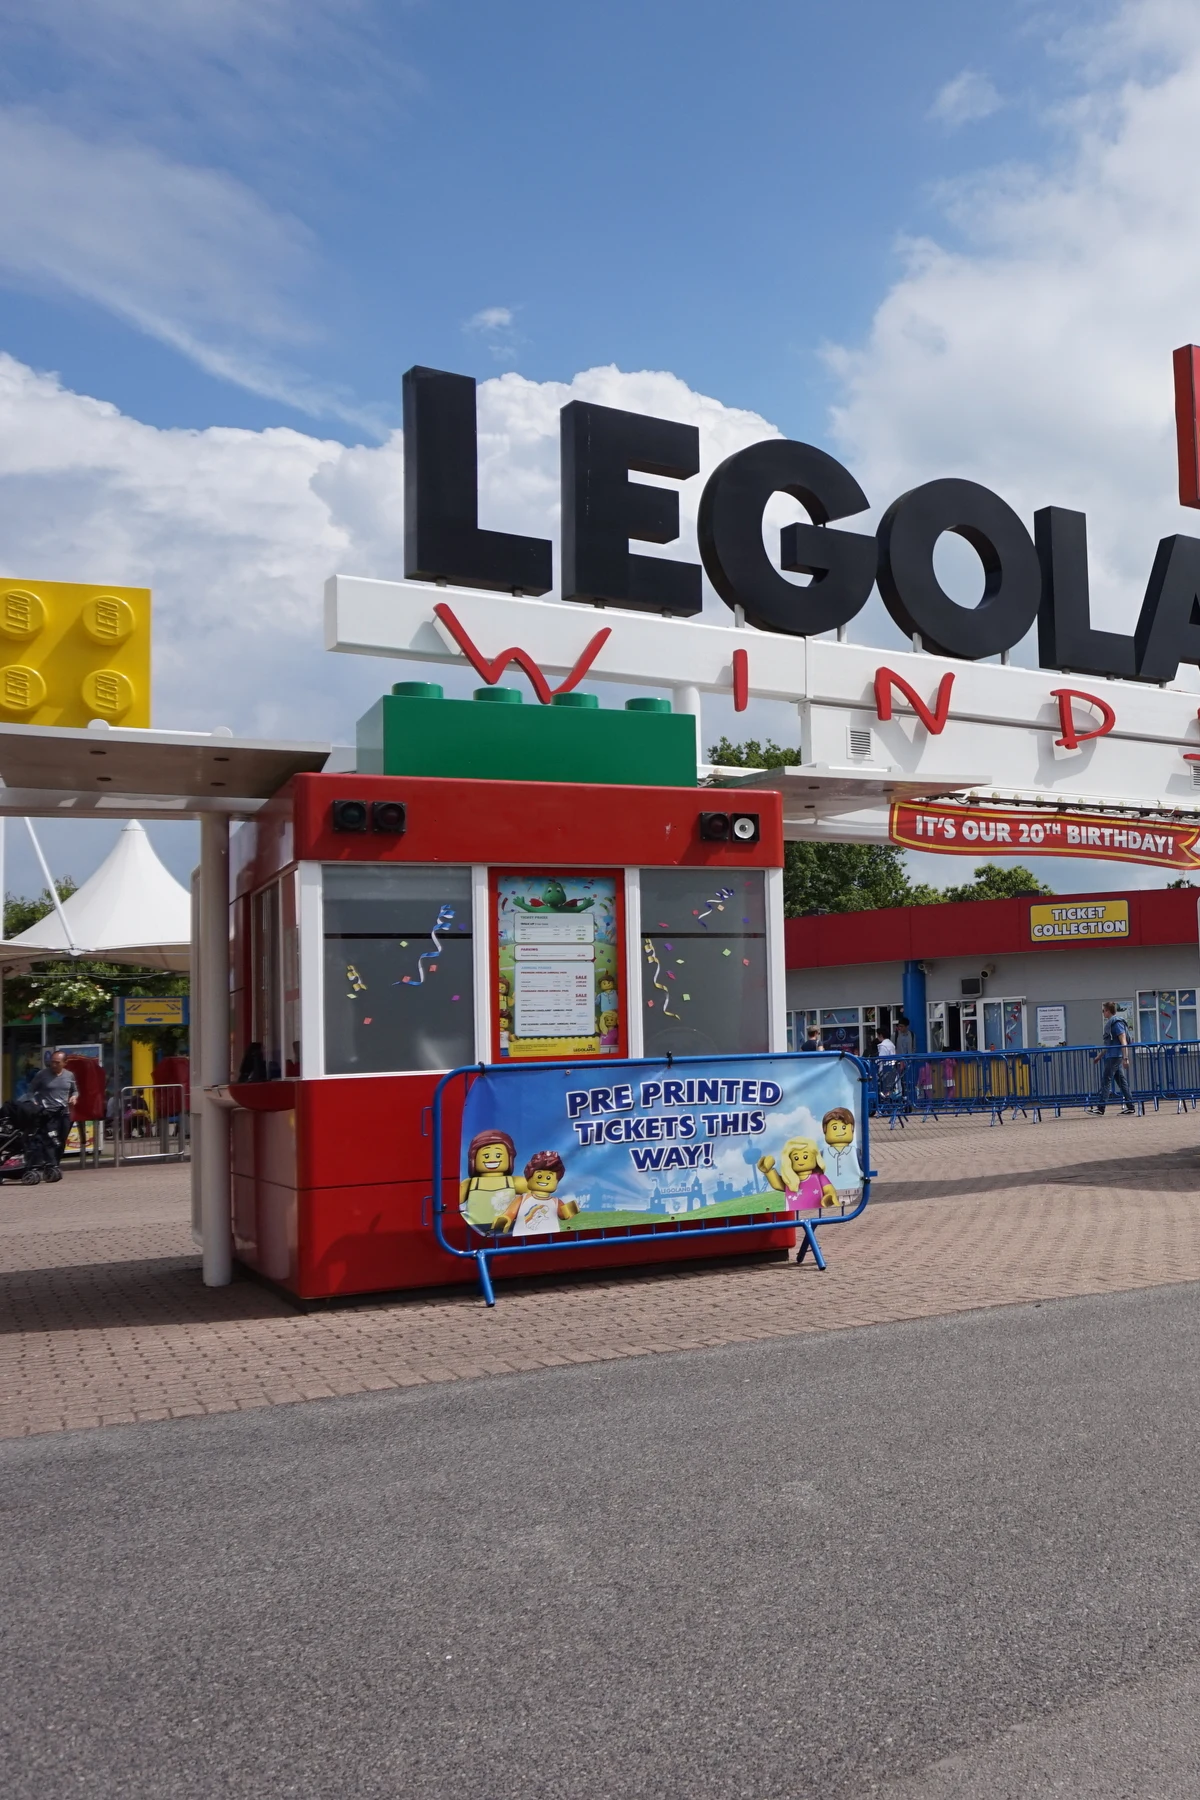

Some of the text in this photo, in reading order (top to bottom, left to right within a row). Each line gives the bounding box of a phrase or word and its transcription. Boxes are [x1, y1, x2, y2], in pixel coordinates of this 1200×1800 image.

[6, 592, 30, 632] LEGO
[96, 599, 119, 637] LEGO
[5, 669, 29, 707] LEGO
[95, 673, 118, 711] LEGO
[915, 815, 1174, 855] IT'S OUR 20TH BIRTHDAY!
[1033, 919, 1127, 938] COLLECTION
[1051, 906, 1106, 921] TICKET
[566, 1079, 783, 1118] PRE PRINTED
[574, 1110, 766, 1145] TICKETS THIS
[630, 1142, 714, 1171] WAY!
